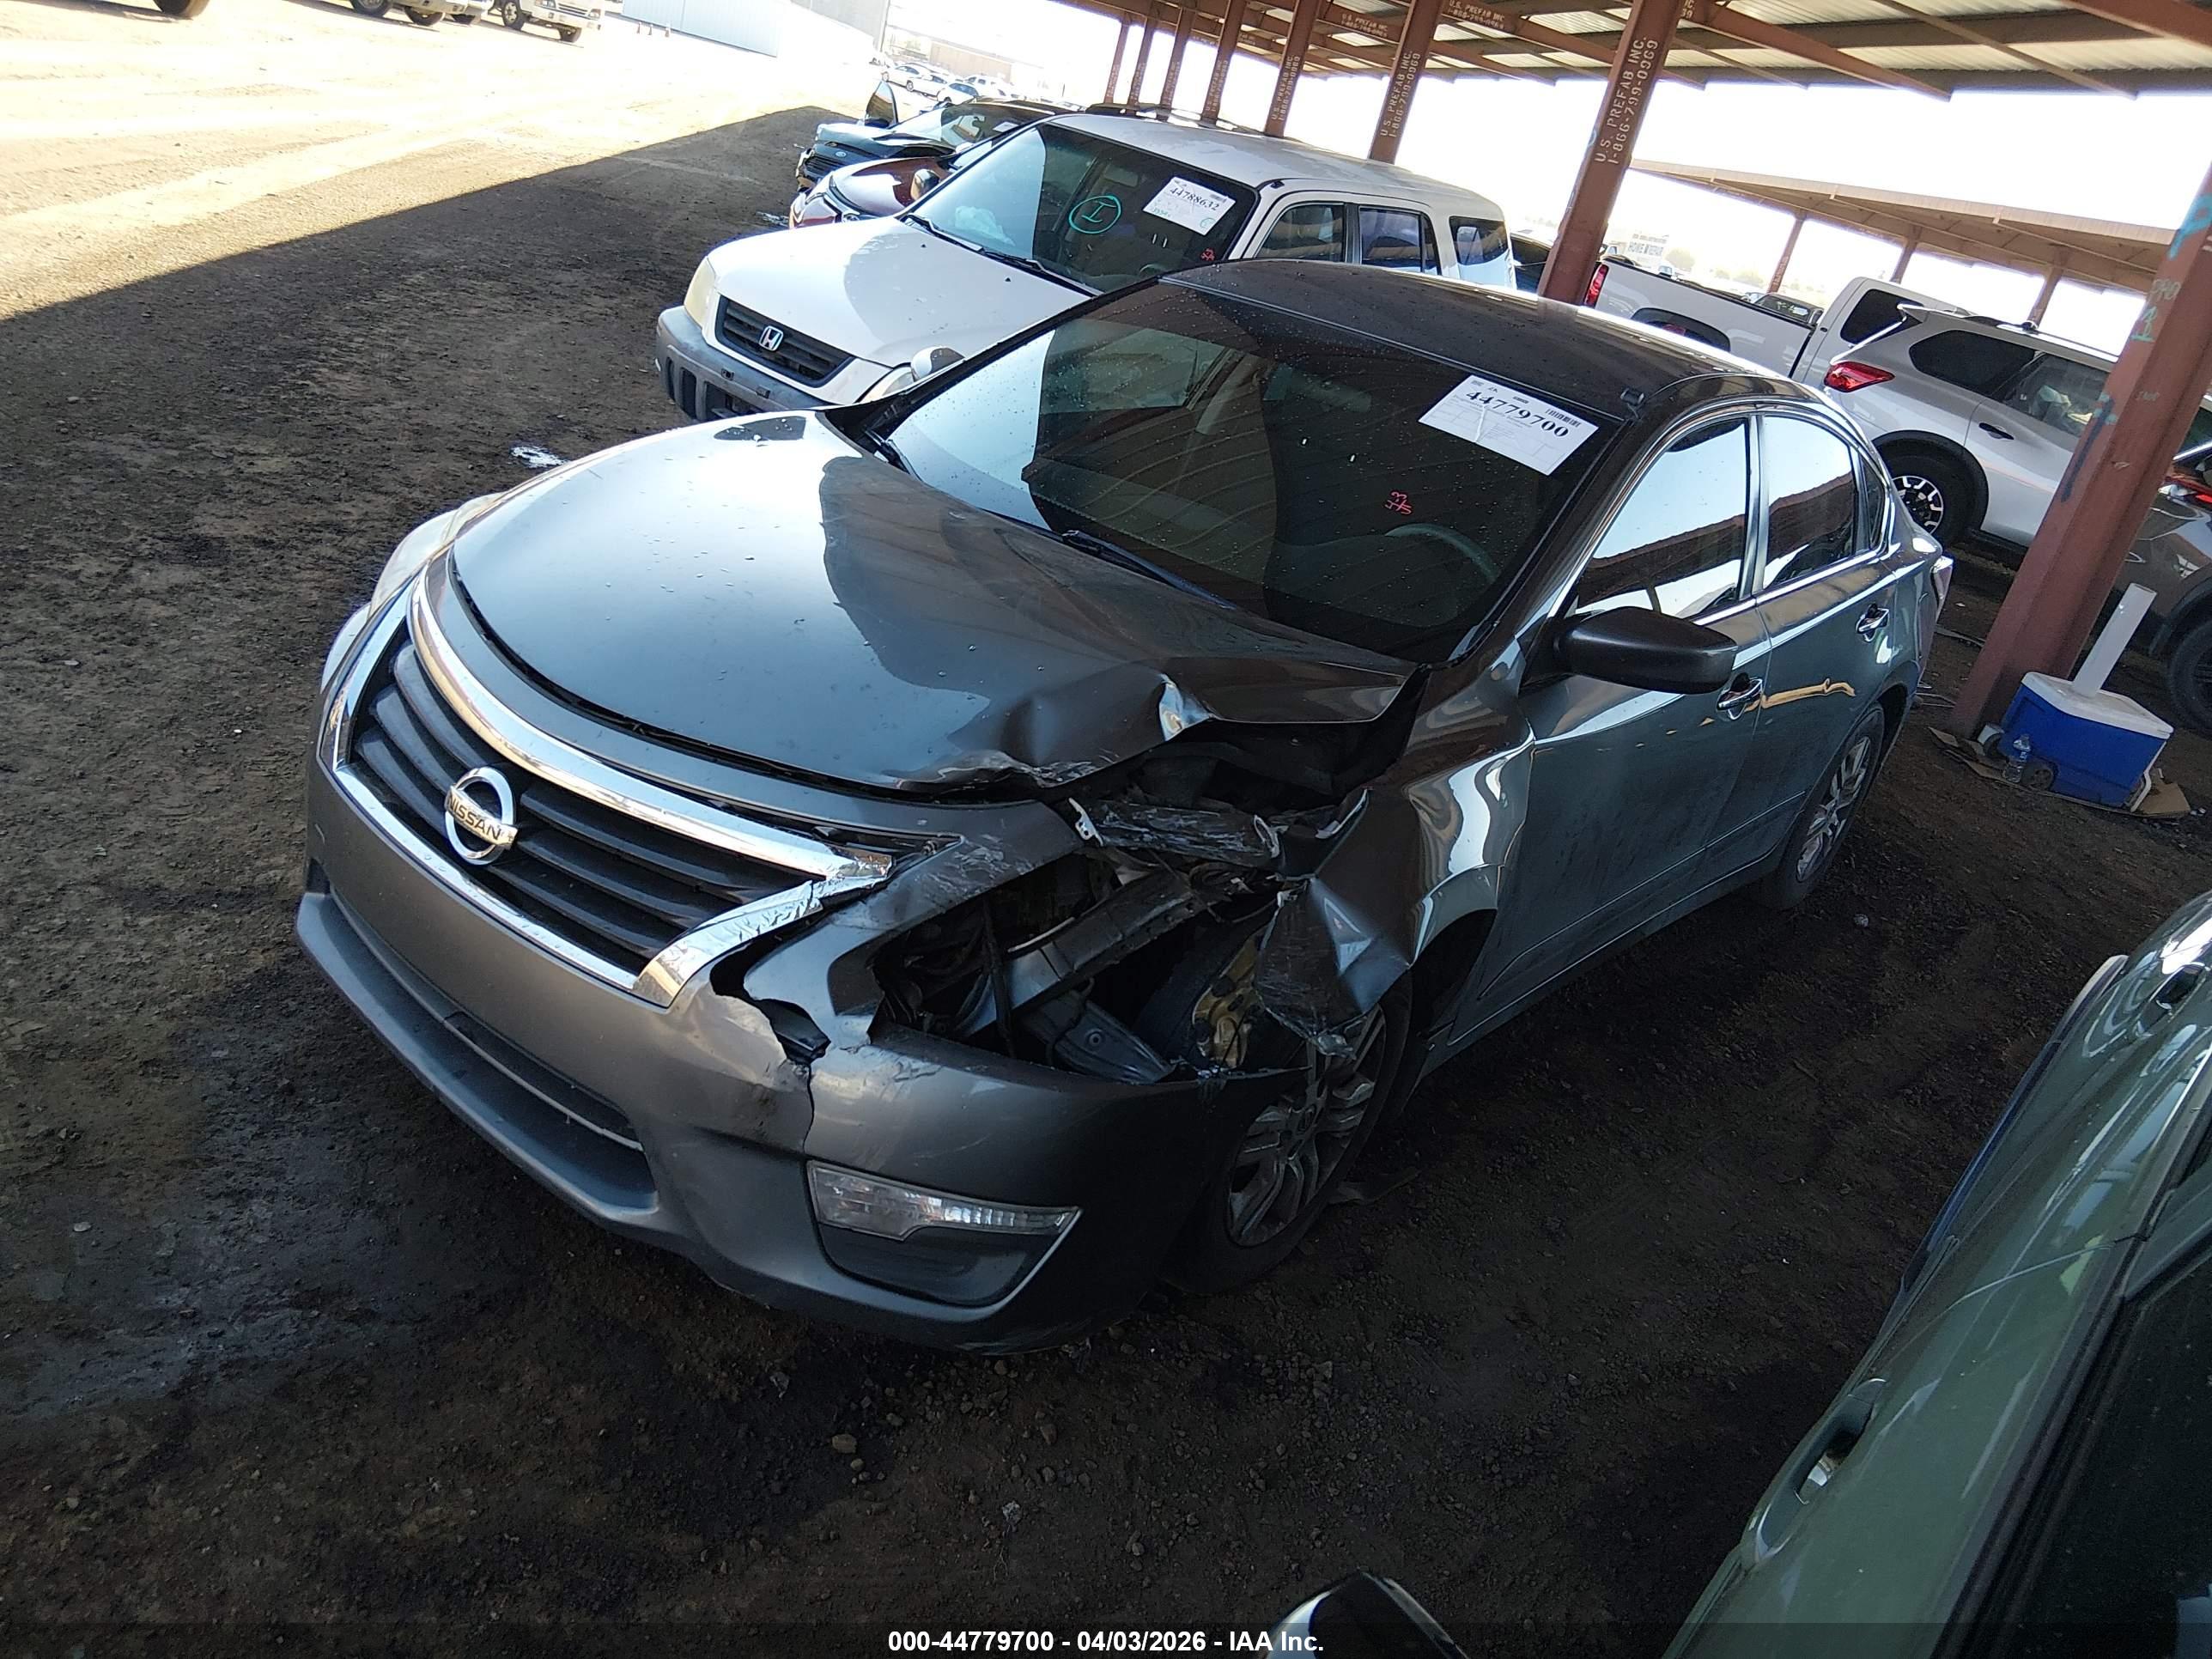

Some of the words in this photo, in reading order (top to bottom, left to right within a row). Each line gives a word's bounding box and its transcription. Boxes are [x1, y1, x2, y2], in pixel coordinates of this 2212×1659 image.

[1388, 74, 1406, 112] PREFAB
[1607, 70, 1634, 128] PREFAB
[1628, 37, 1647, 64] INC.
[1607, 40, 1658, 164] 1-866-799-0969
[1170, 187, 1220, 211] 44788632
[1466, 392, 1569, 437] 44779700
[447, 797, 502, 841] NISSAN
